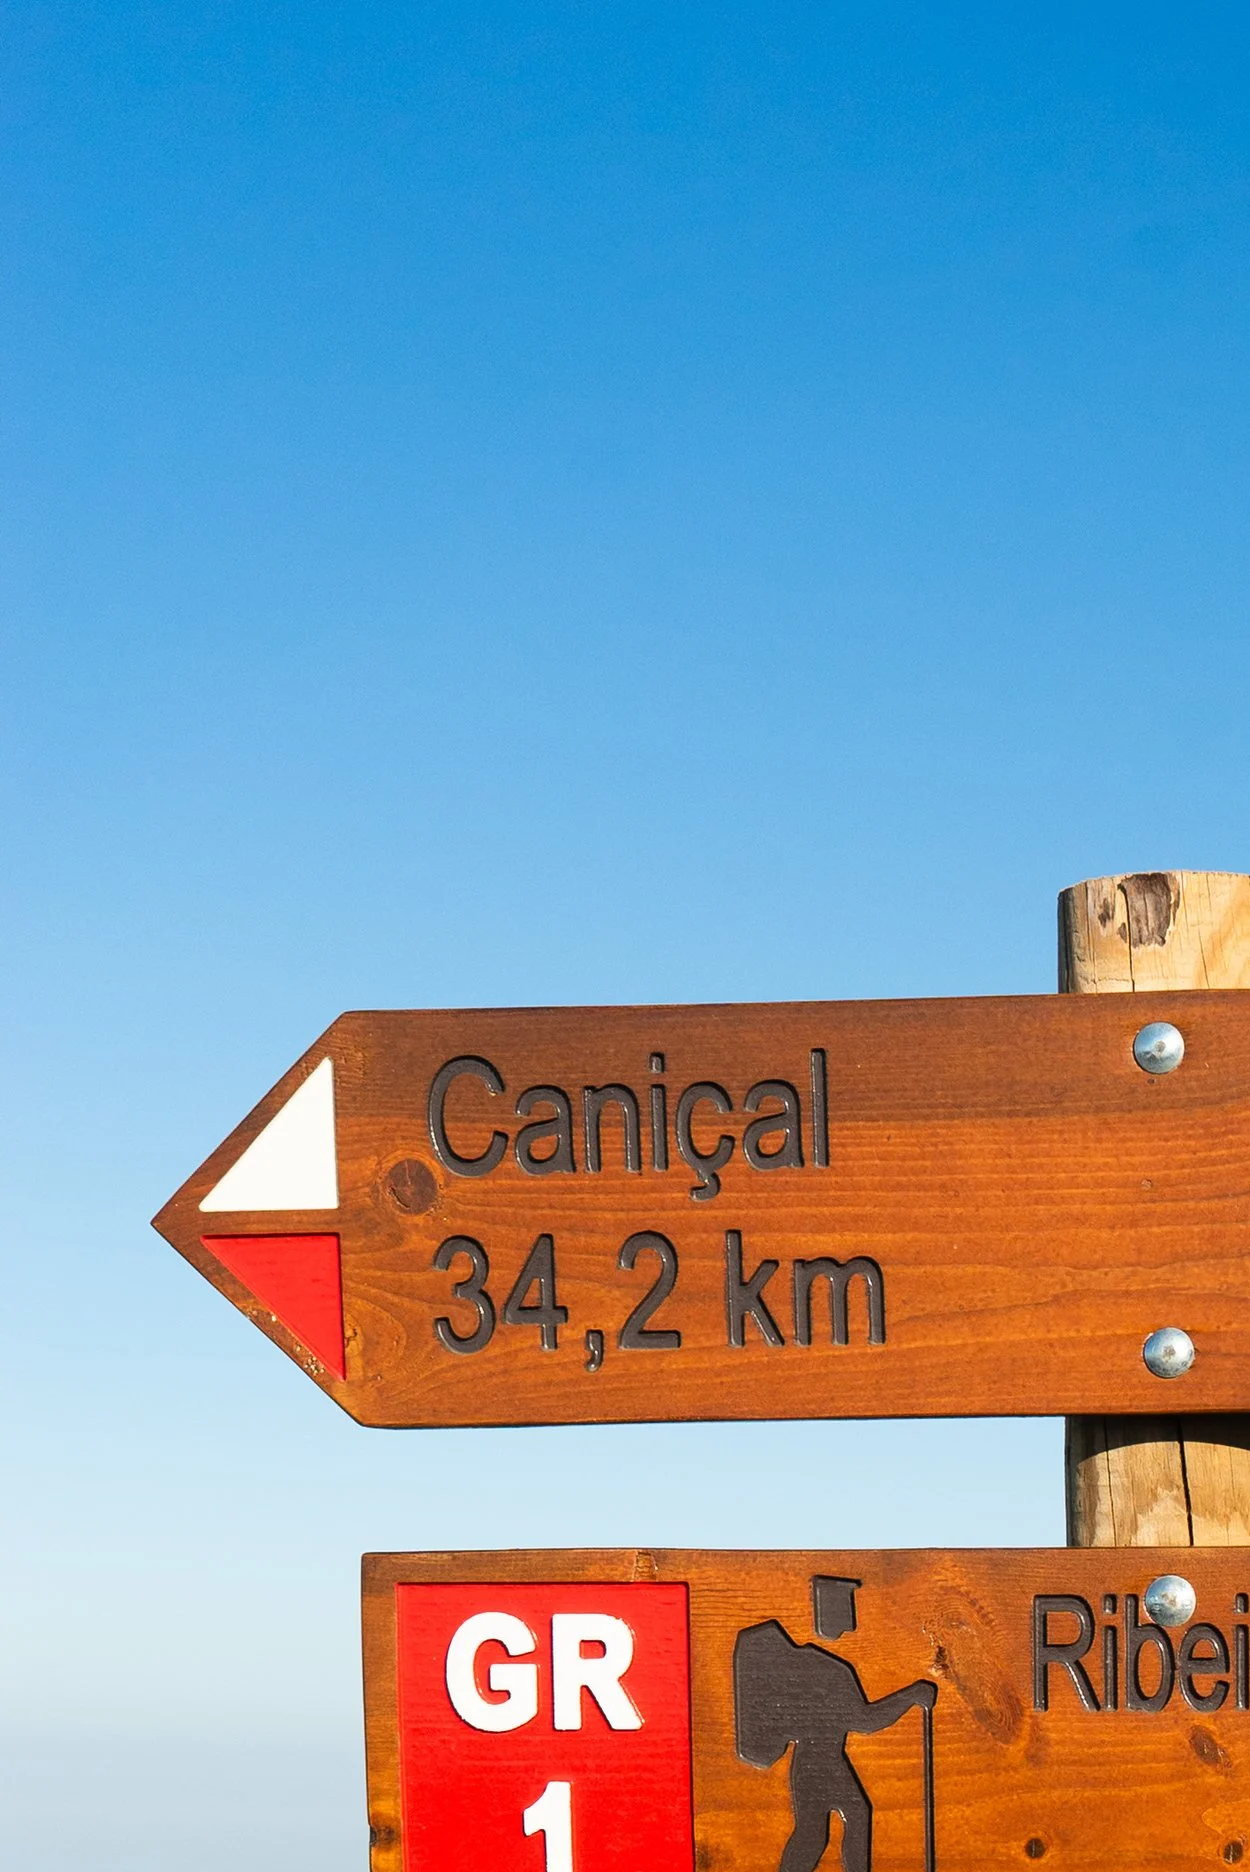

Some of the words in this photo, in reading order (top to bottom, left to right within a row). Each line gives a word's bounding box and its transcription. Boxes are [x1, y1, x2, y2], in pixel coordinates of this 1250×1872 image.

[428, 1046, 830, 1201] Caniçal
[432, 1229, 682, 1373] 34,2
[724, 1229, 887, 1348] km
[446, 1610, 646, 1733] GR
